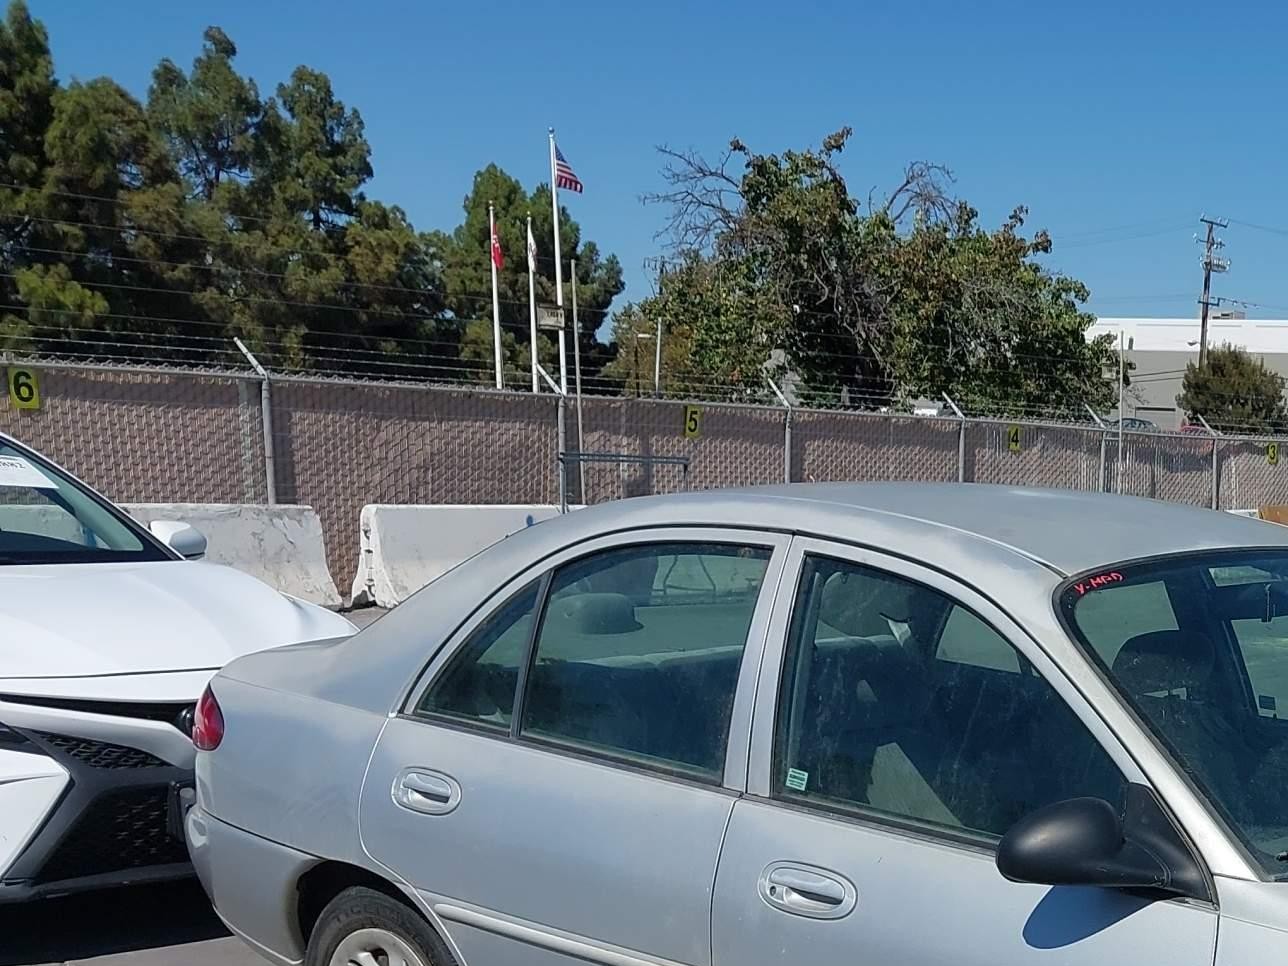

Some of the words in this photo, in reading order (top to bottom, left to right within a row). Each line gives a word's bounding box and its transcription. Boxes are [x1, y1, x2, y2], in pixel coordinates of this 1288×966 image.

[13, 371, 34, 403] 6
[688, 410, 698, 433] 5
[1011, 427, 1020, 447] 4
[1270, 444, 1276, 460] 3
